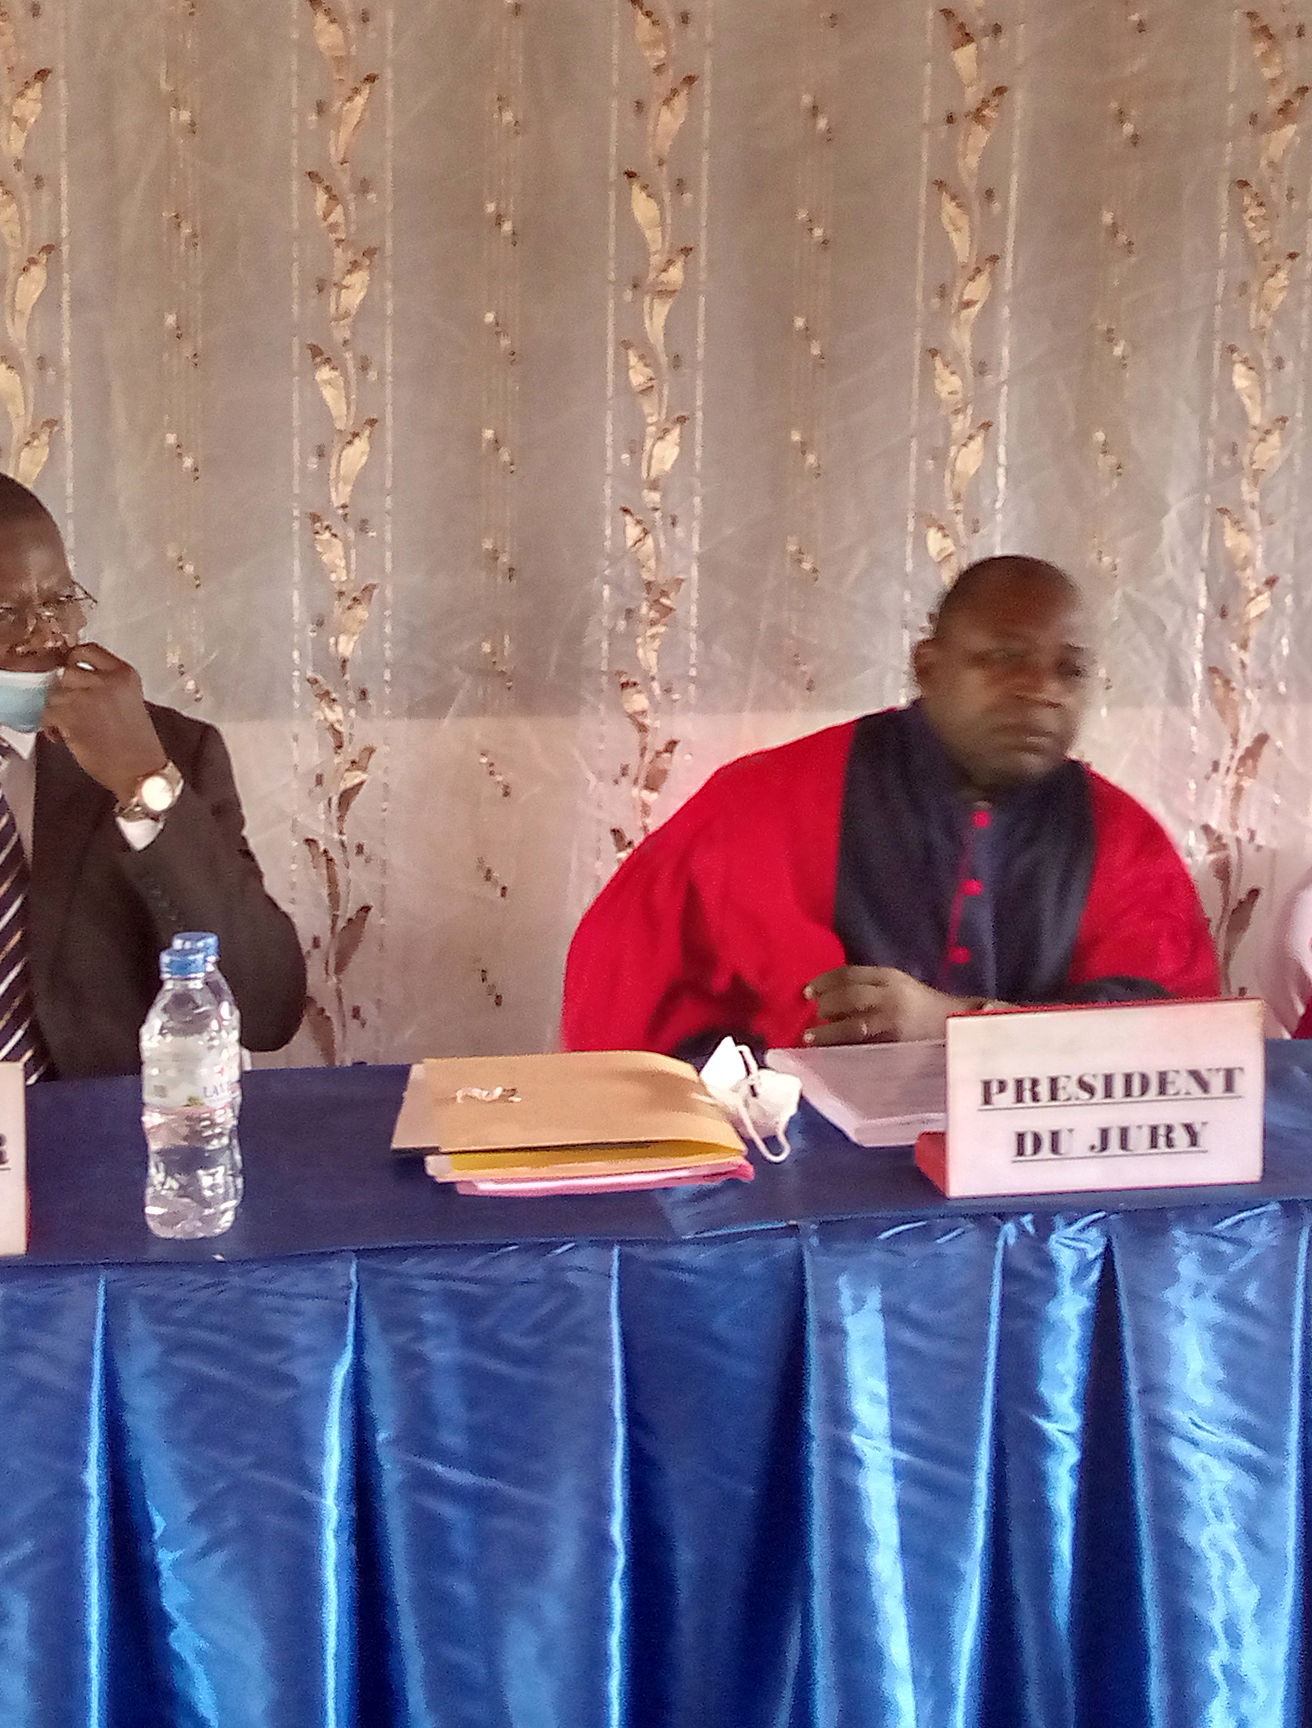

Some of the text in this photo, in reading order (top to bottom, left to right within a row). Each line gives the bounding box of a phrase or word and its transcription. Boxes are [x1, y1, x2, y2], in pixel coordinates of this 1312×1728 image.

[979, 1067, 1245, 1107] PRESIDENT
[1014, 1121, 1208, 1158] DU JURY
